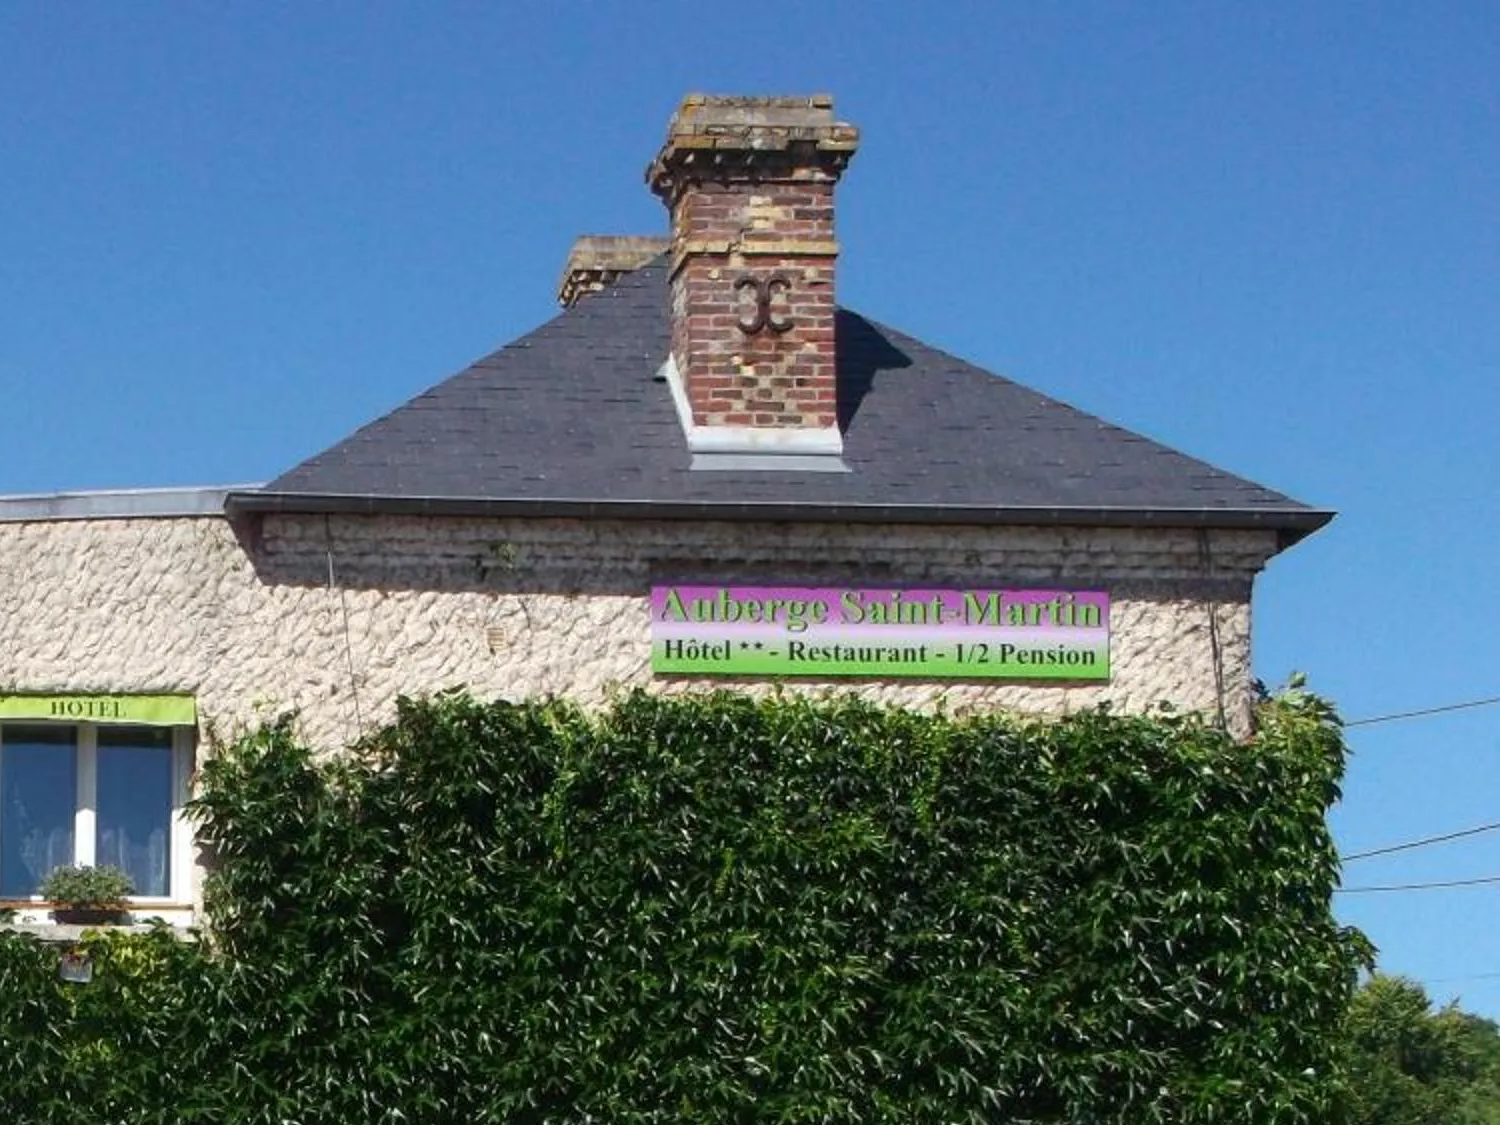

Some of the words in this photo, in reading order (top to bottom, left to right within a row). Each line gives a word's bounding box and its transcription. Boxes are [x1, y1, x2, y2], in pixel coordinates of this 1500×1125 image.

[661, 589, 829, 632] Auberge
[664, 638, 731, 661] Hôtel
[788, 641, 927, 664] Restaurant
[956, 643, 989, 664] 1/2
[1000, 643, 1096, 666] Pension
[51, 701, 126, 718] HOTEL
